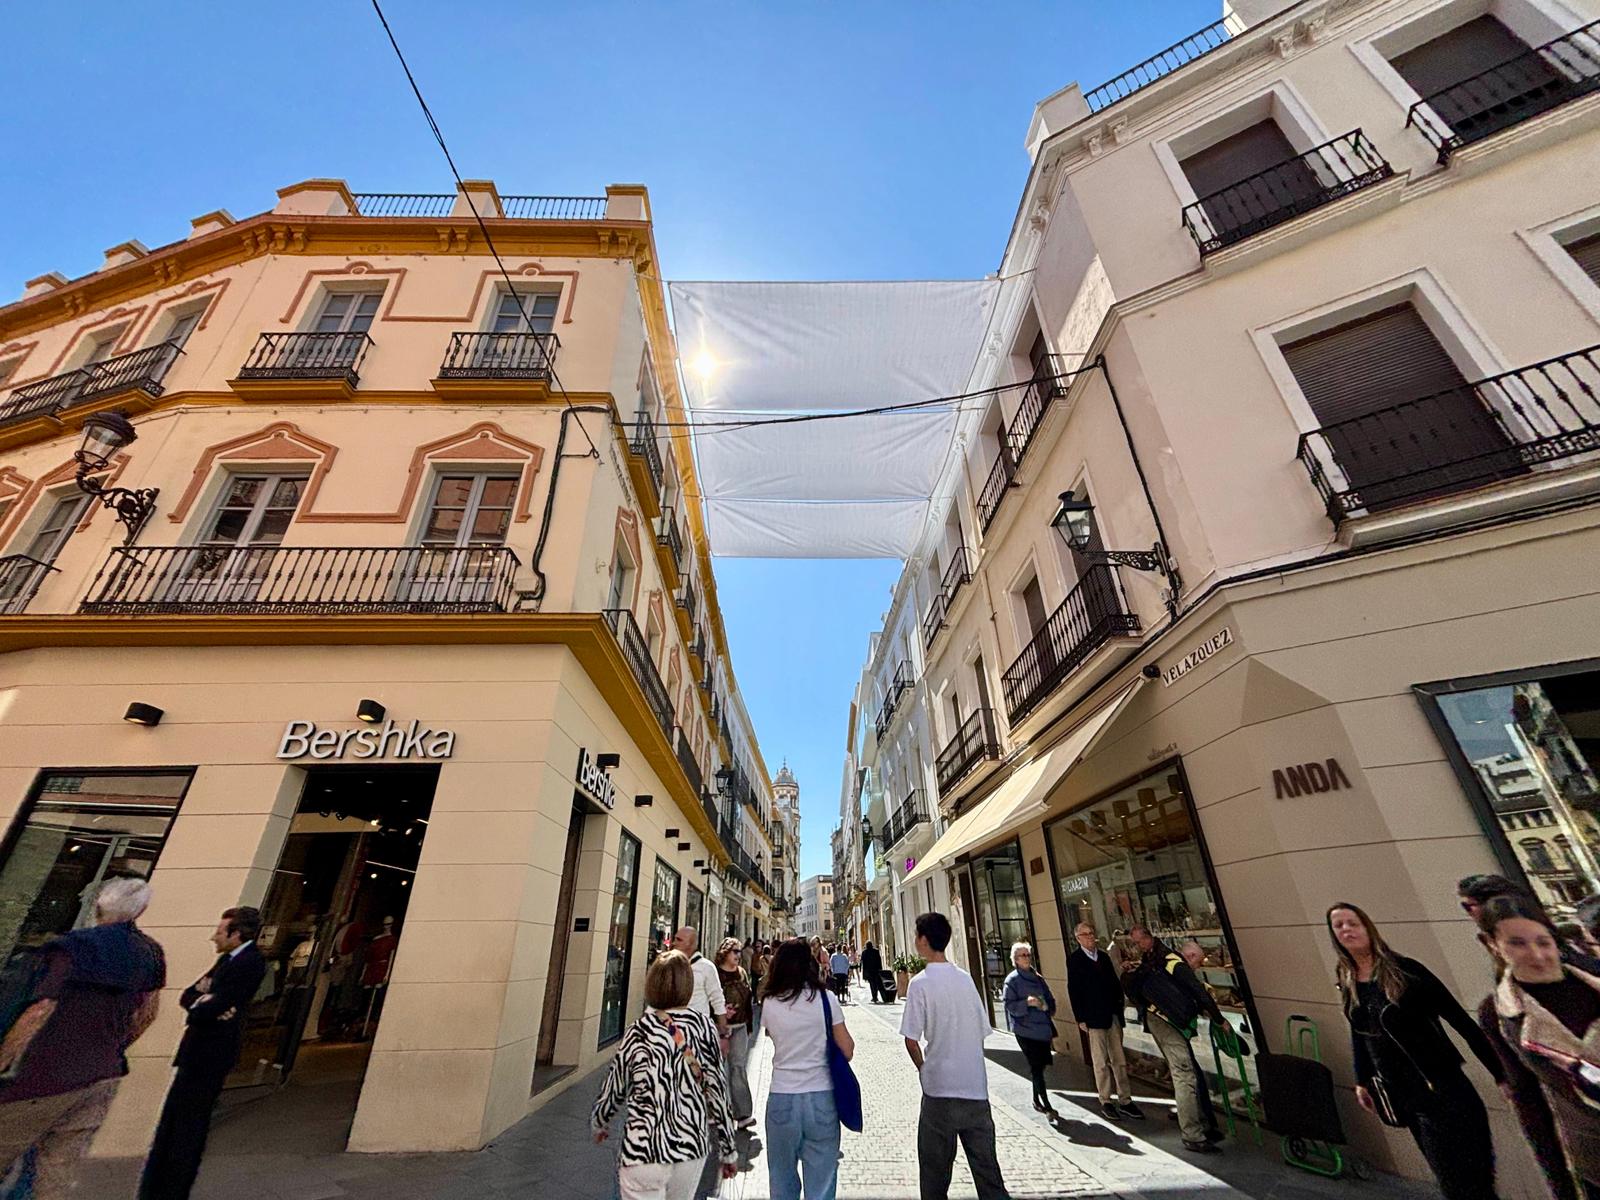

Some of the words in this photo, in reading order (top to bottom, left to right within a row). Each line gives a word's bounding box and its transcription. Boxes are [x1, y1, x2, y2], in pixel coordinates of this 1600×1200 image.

[1162, 629, 1231, 685] VELAZQUEZ
[275, 719, 456, 760] Bershka
[1272, 758, 1352, 799] ANDA
